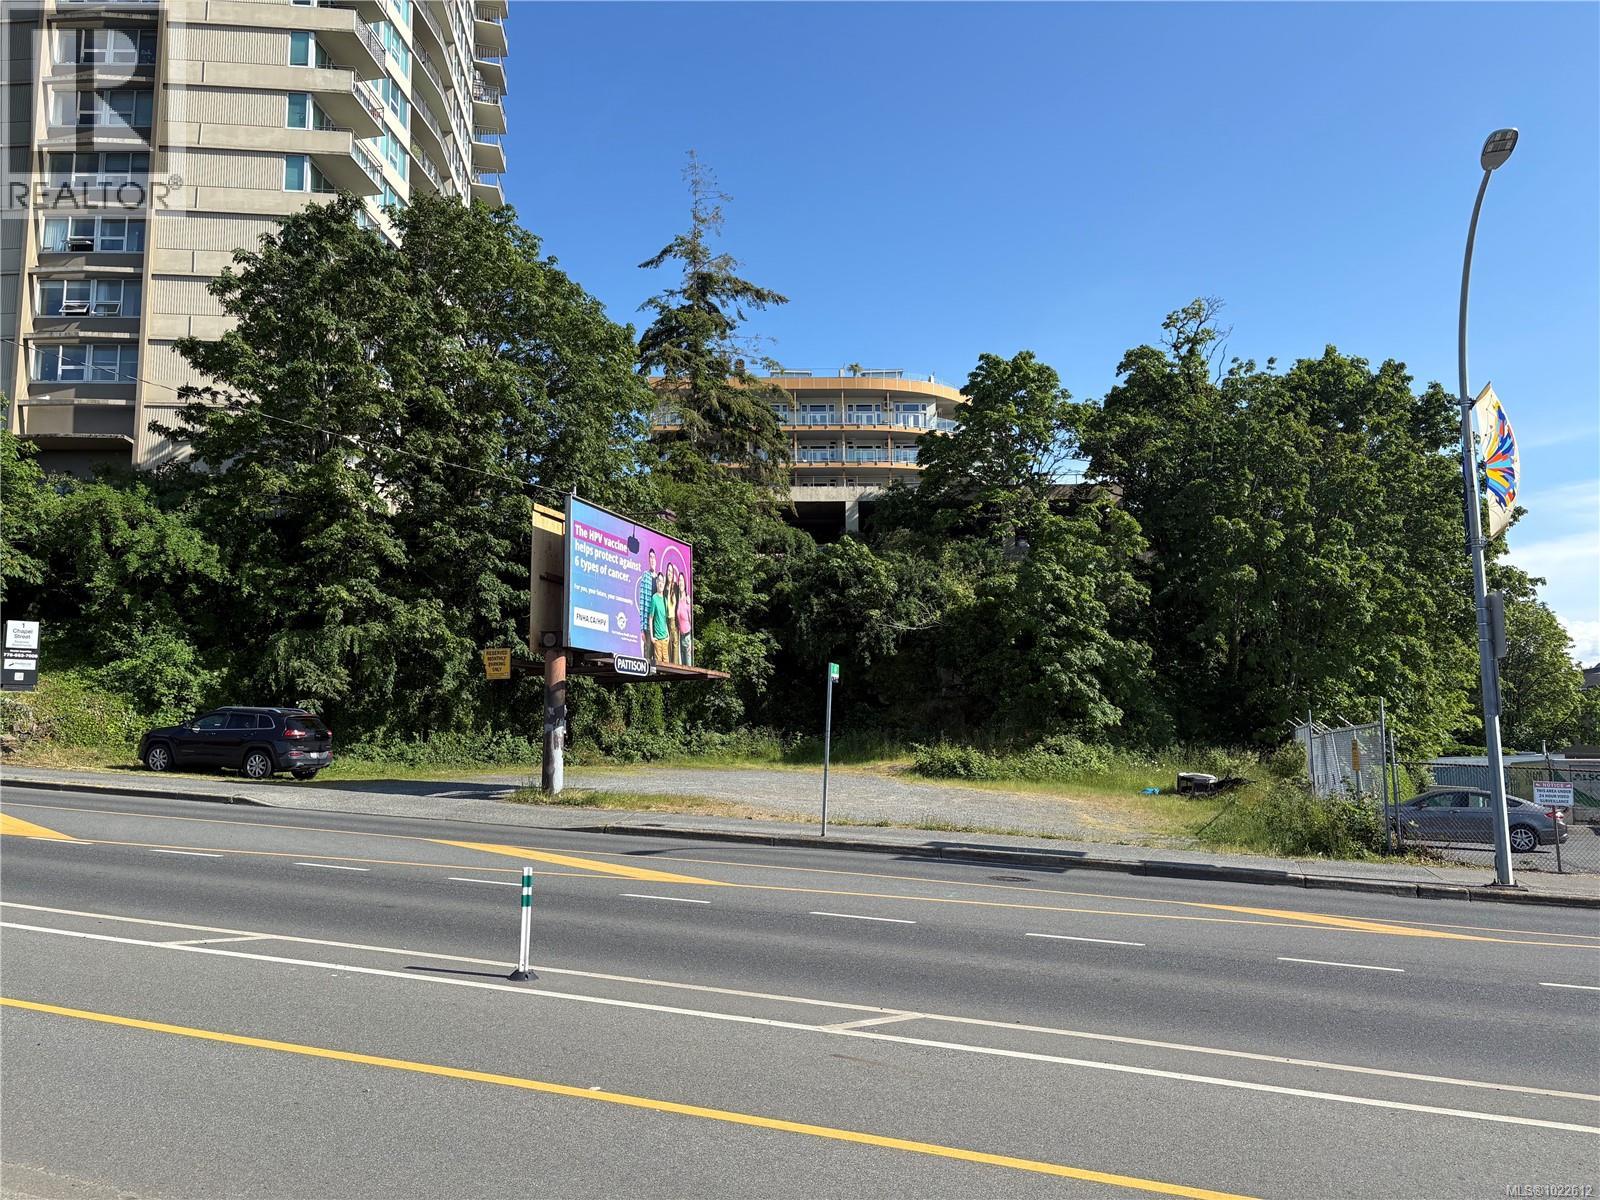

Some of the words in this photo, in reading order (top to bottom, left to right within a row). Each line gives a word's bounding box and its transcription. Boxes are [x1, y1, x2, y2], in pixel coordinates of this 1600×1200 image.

[574, 524, 588, 538] The
[589, 530, 603, 543] HPV
[604, 538, 628, 553] vaccine
[574, 539, 594, 556] helps
[594, 548, 619, 565] protect
[619, 557, 642, 572] against
[574, 556, 580, 566] 6
[580, 559, 599, 573] types
[599, 564, 608, 575] of
[607, 567, 631, 583] cancer.
[617, 658, 647, 673] PATTISON
